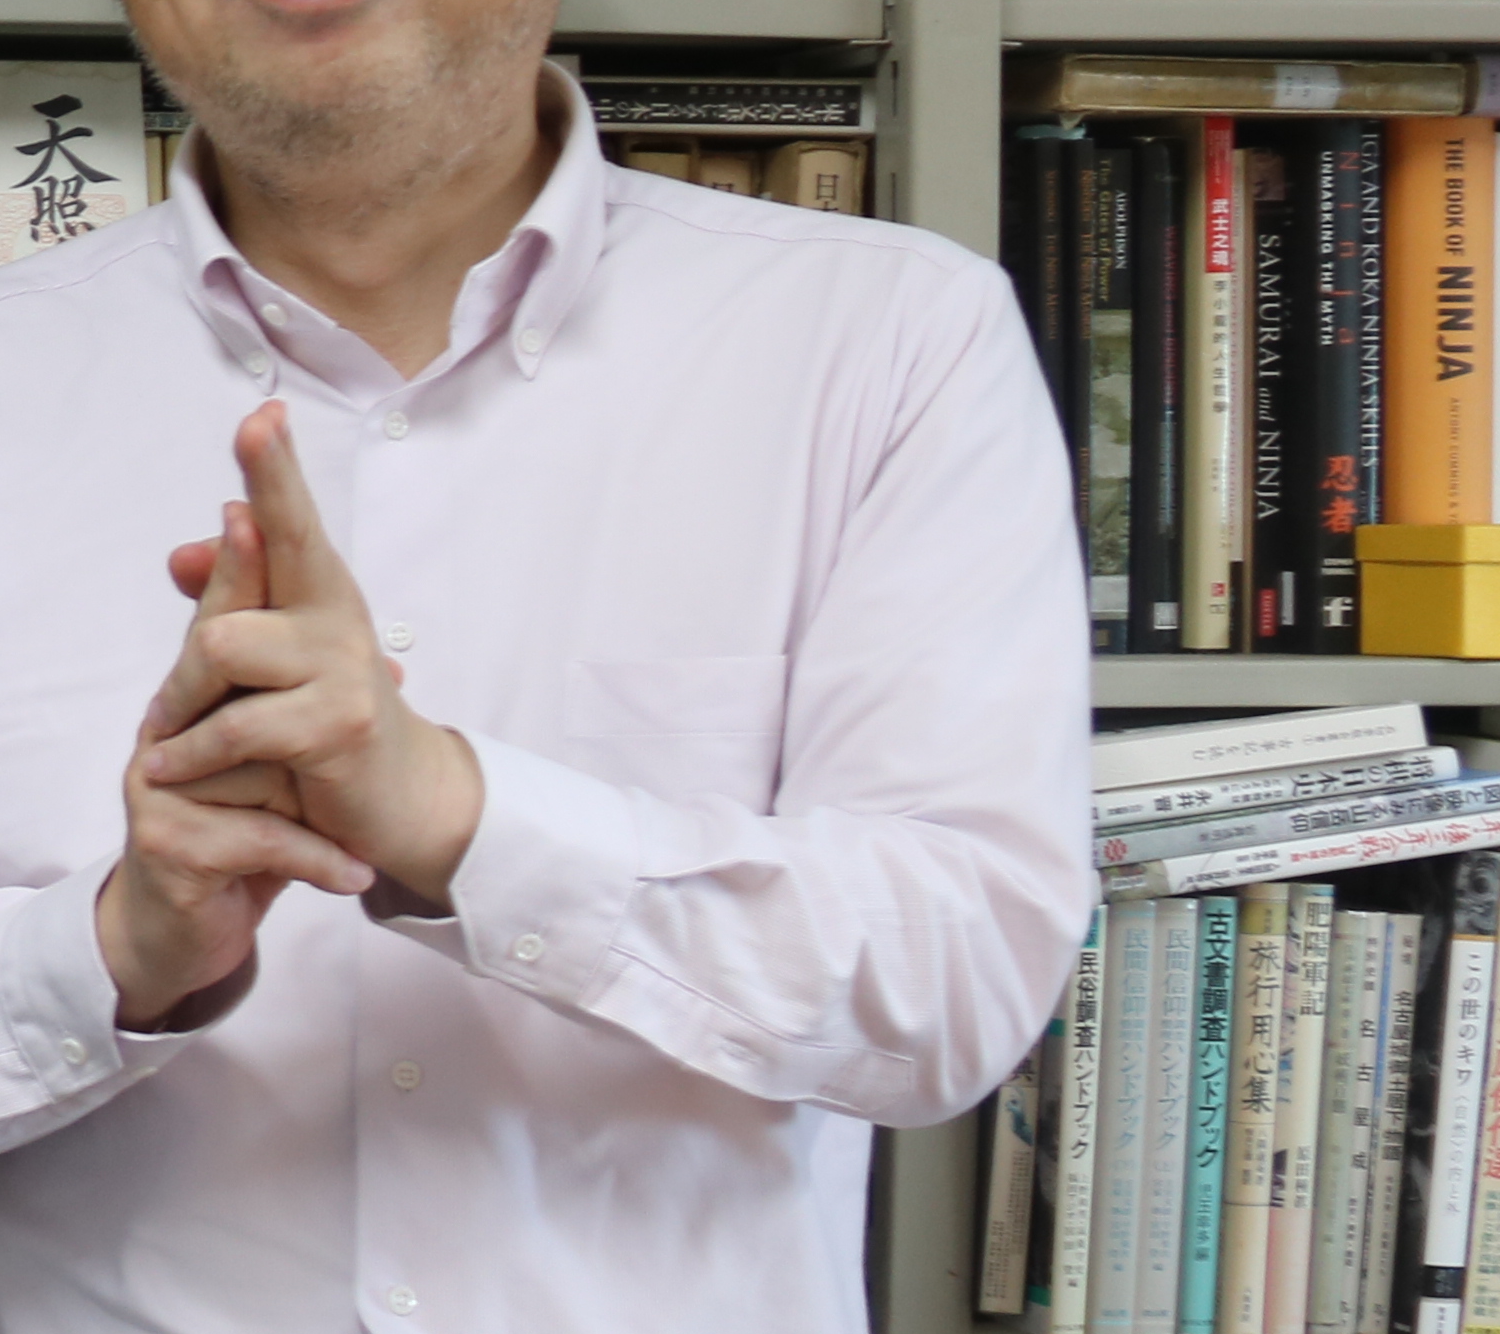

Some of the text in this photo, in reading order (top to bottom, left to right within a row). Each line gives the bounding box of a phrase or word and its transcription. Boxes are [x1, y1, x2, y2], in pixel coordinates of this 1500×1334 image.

[1361, 179, 1381, 235] AND
[1361, 243, 1381, 308] KOKA
[1436, 138, 1475, 382] THE BOOK OF NINJA
[1257, 234, 1282, 520] SAMURAI and NINJA
[1361, 313, 1381, 386] NINJA
